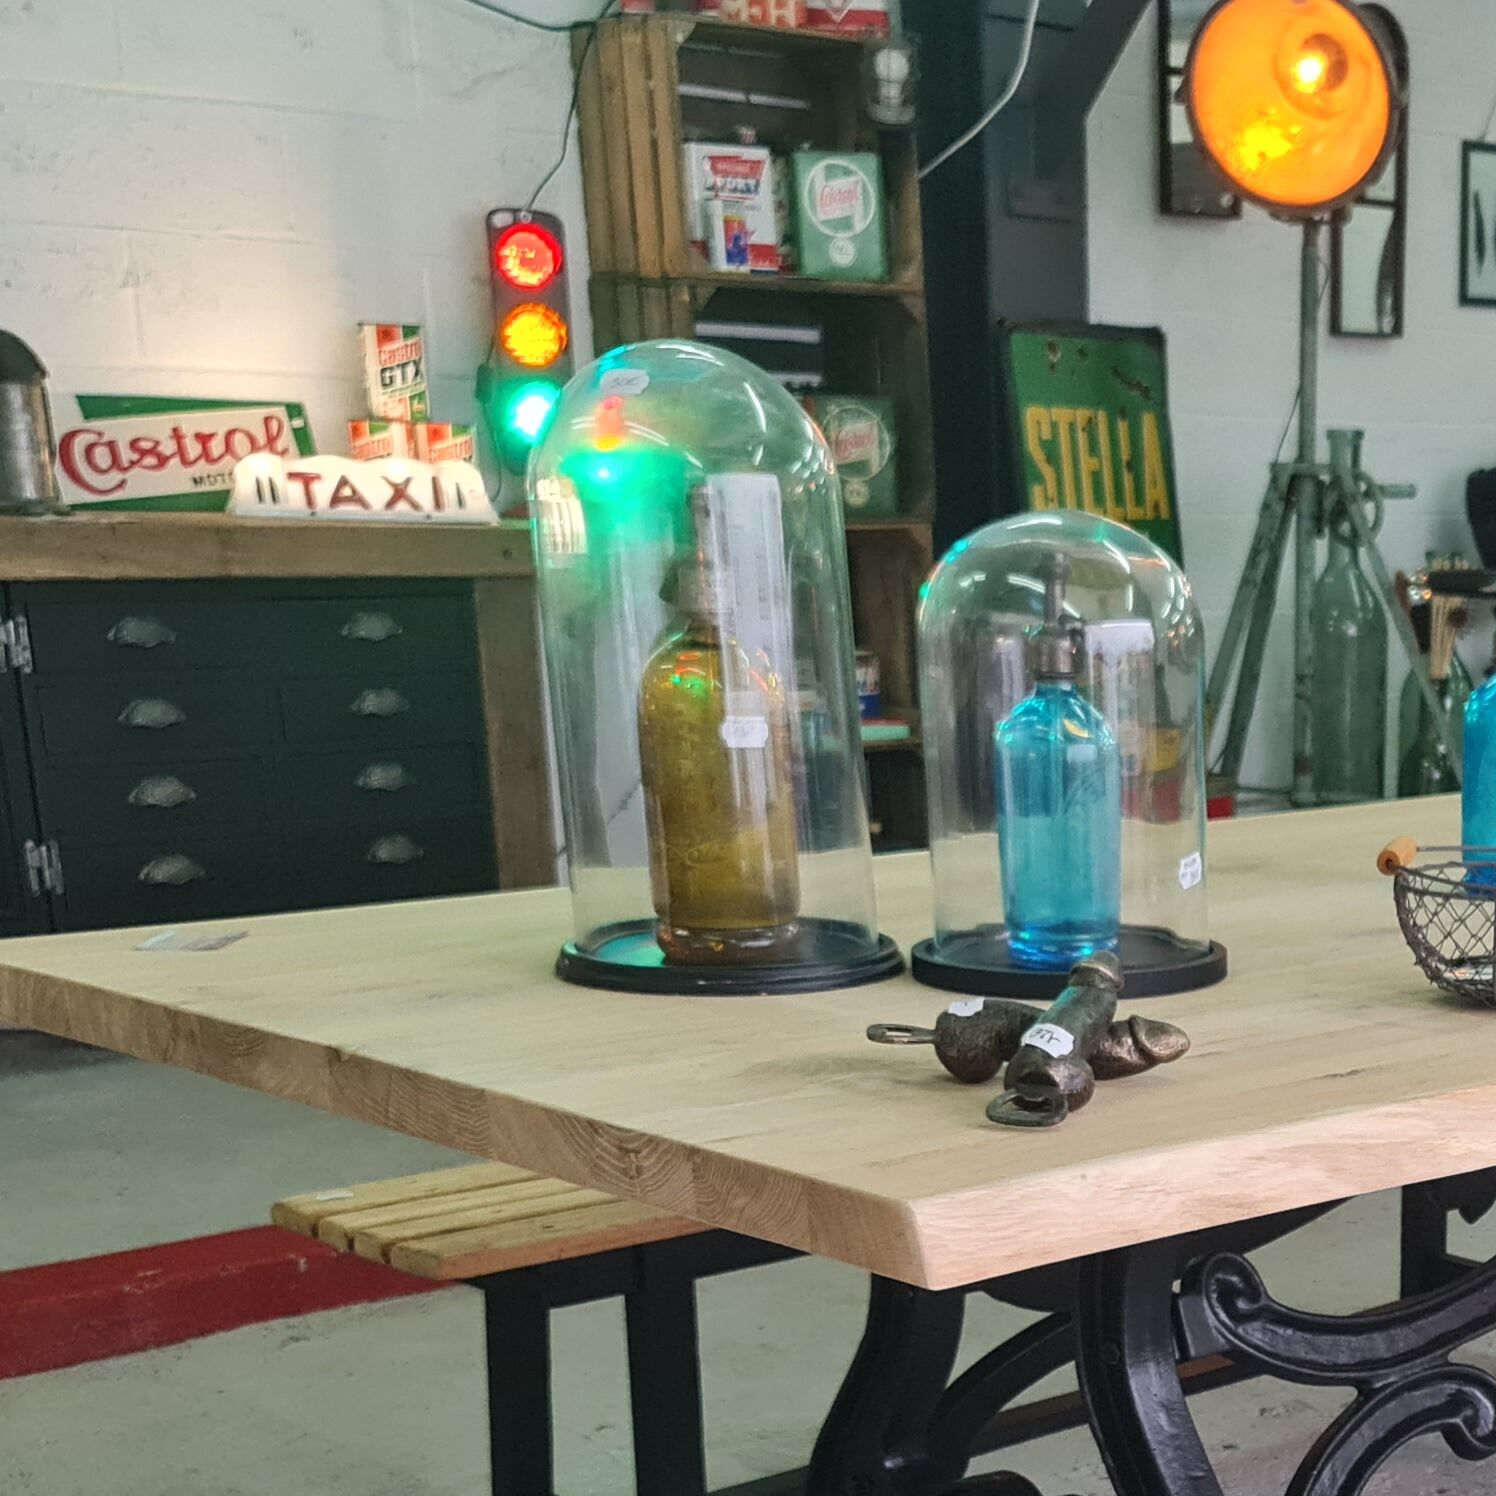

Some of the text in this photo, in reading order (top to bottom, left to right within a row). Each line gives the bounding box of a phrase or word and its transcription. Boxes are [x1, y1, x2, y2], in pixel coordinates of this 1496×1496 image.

[380, 357, 423, 388] GTX
[59, 414, 289, 497] Castrol
[1025, 404, 1170, 520] STELLA
[287, 471, 445, 512] TAXI
